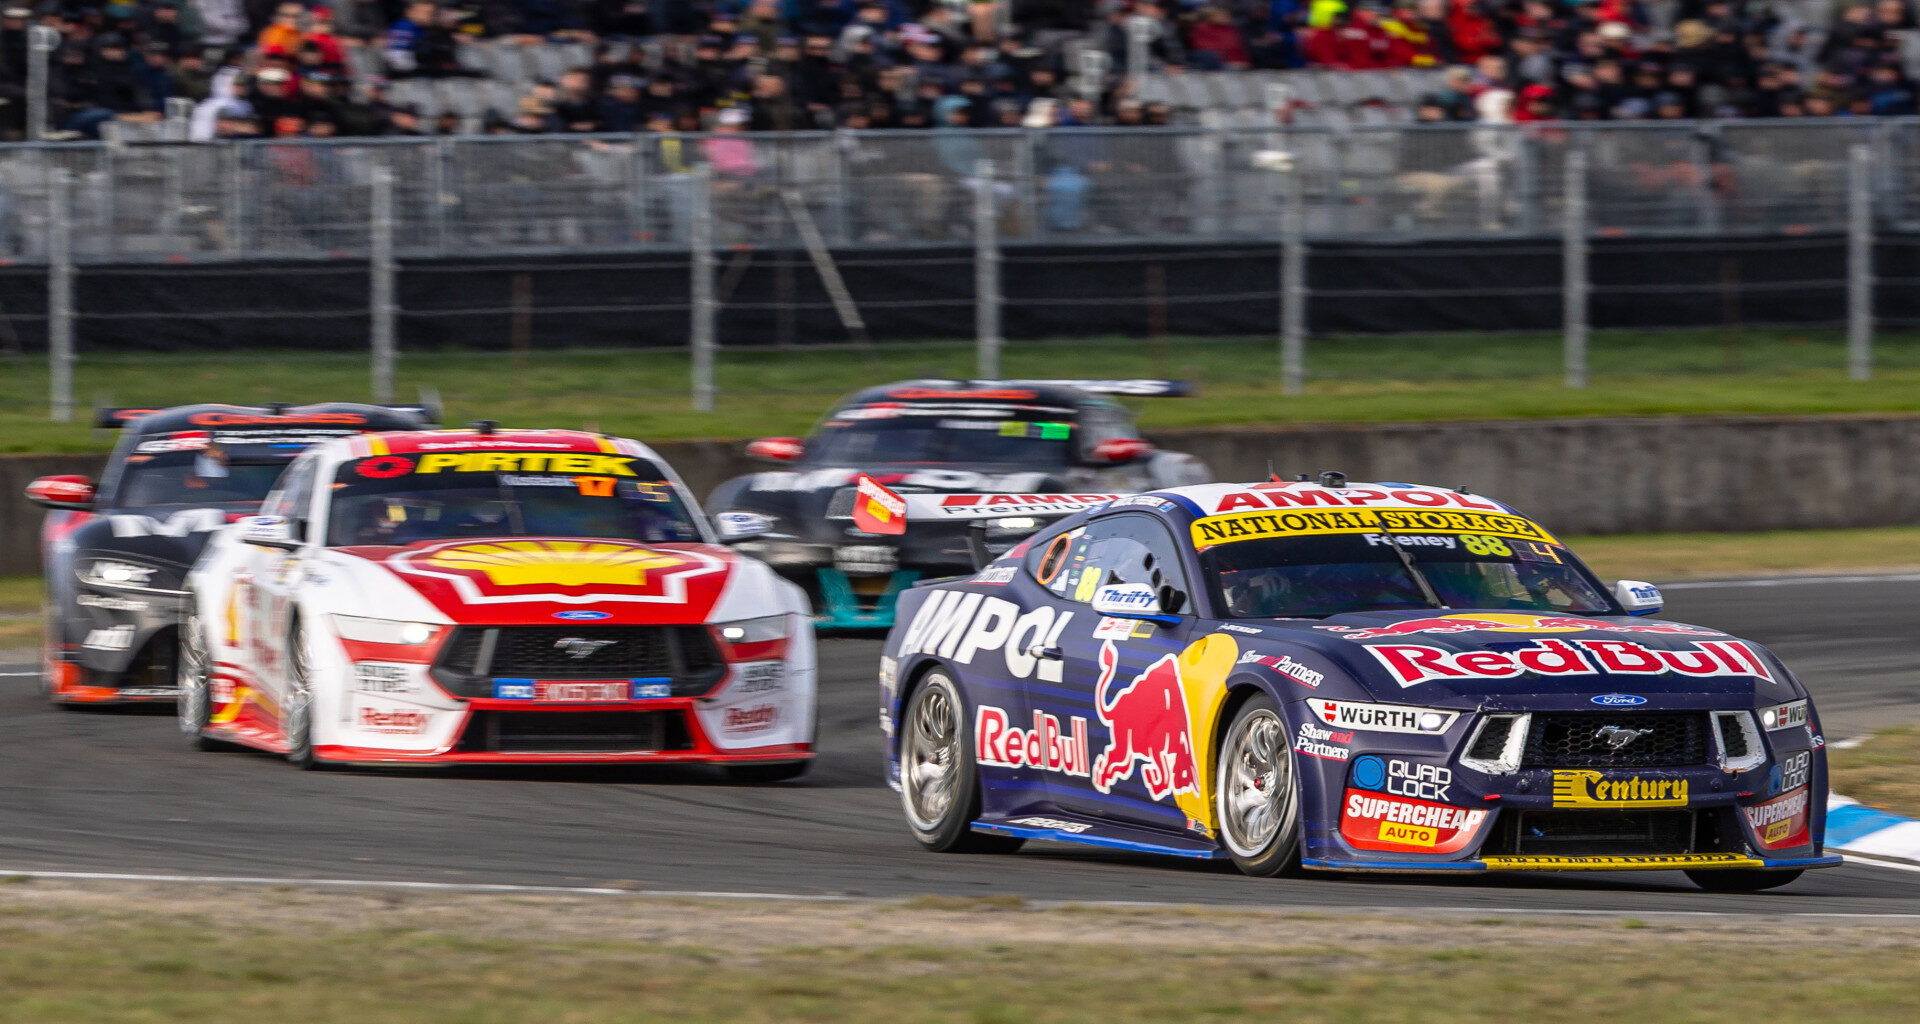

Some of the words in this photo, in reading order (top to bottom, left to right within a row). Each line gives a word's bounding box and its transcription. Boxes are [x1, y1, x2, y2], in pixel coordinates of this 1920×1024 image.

[414, 453, 639, 477] PIRTEK
[1215, 488, 1498, 513] AMPOL
[1197, 511, 1377, 541] NATIONAL
[1380, 510, 1538, 537] STORAGE
[1361, 533, 1457, 549] Feeney
[1458, 534, 1513, 558] 88
[1101, 589, 1158, 608] Thrifty
[898, 589, 1076, 684] AMPOL
[1294, 736, 1350, 760] Partners
[1388, 759, 1452, 785] QUAD
[1387, 775, 1451, 801] LOCK
[1552, 769, 1689, 808] Century
[1346, 794, 1483, 832] SUPERCHEAP
[1385, 827, 1431, 842] AUTO
